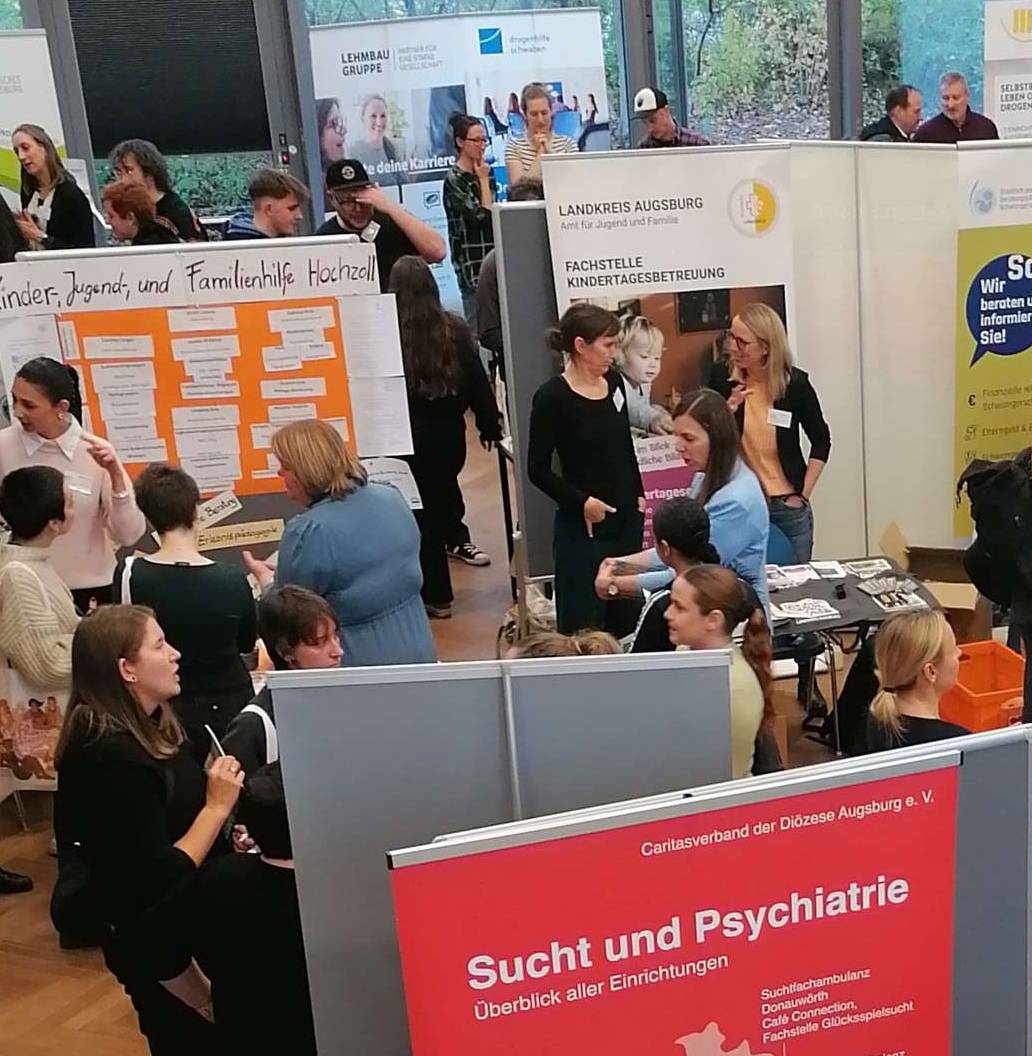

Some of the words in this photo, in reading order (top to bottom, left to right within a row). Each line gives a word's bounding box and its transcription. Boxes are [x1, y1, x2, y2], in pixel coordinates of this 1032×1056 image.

[341, 49, 390, 63] LEHMBAU
[342, 62, 383, 76] GRUPPE
[1000, 92, 1026, 103] LEBEN
[376, 160, 408, 175] deine
[409, 155, 456, 171] Karriere
[558, 201, 631, 217] LANDKREIS
[634, 197, 704, 213] AUGSBURG
[560, 220, 579, 231] Amt
[581, 219, 594, 230] für
[595, 217, 628, 231] Jugend
[630, 216, 646, 227] und
[647, 214, 680, 226] Familie
[565, 256, 643, 272] FACHSTELLE
[0, 274, 60, 309] inder-,
[138, 270, 173, 294] und
[186, 258, 295, 296] Familienhilfe
[308, 255, 376, 287] Hochzoll
[567, 267, 726, 288] KINDERTAGESBETREUUNG
[980, 278, 1007, 294] Wir
[980, 297, 1024, 311] beraten
[980, 329, 1007, 345] Sie!
[640, 824, 750, 857] Caritasverband
[752, 820, 776, 836] der
[779, 809, 836, 833] Diözese
[837, 796, 903, 821] Augsburg
[905, 794, 918, 807] e.
[921, 788, 935, 804] V.
[466, 937, 593, 991] Sucht
[604, 916, 682, 962] und
[694, 874, 911, 944] Psychiatrie
[473, 989, 562, 1021] Überblick
[566, 980, 605, 1003] aller
[608, 953, 730, 993] Einrichtungen
[760, 968, 872, 1001] Suchtfachambulanz
[761, 990, 829, 1016] Donauwörth
[762, 1014, 789, 1029] Café
[791, 1000, 858, 1023] Connection,
[762, 1021, 819, 1045] Fachstelle
[821, 1001, 915, 1030] Glücksspielsucht
